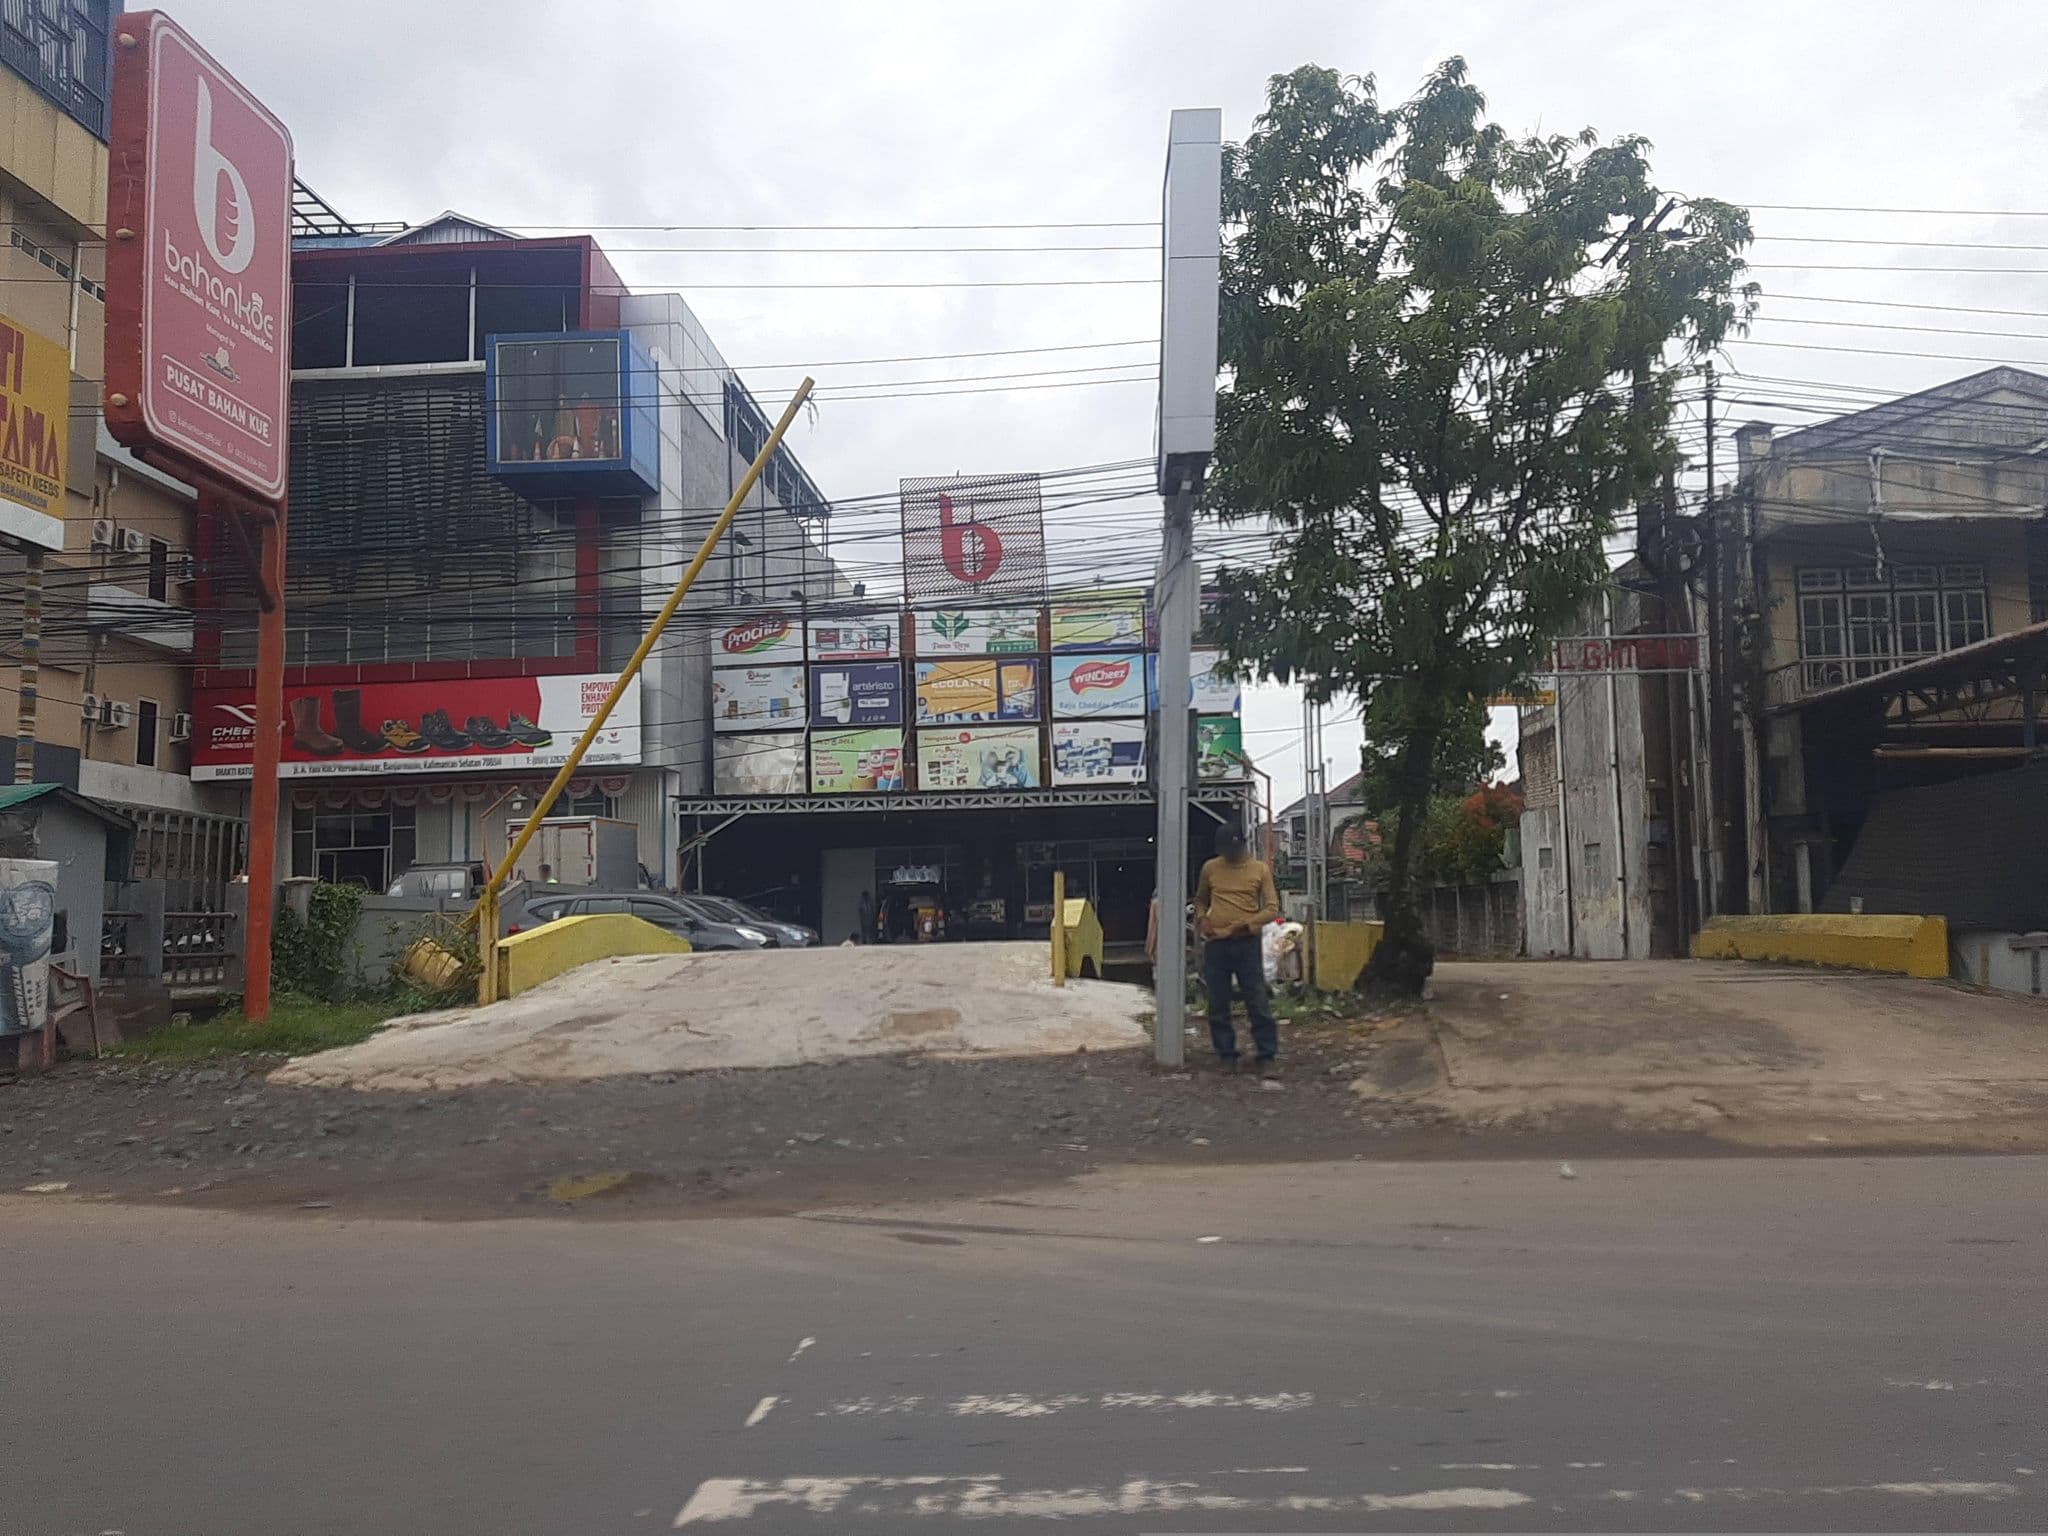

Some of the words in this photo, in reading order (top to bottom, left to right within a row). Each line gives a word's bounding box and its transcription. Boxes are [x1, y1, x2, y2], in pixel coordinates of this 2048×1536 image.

[166, 364, 206, 401] PUSAT
[207, 389, 247, 426] BAHAN
[248, 412, 270, 439] KUE
[33, 477, 60, 500] NEEDS
[581, 682, 617, 693] EMPOWE
[581, 693, 609, 703] ENHAN
[581, 704, 602, 714] PROT
